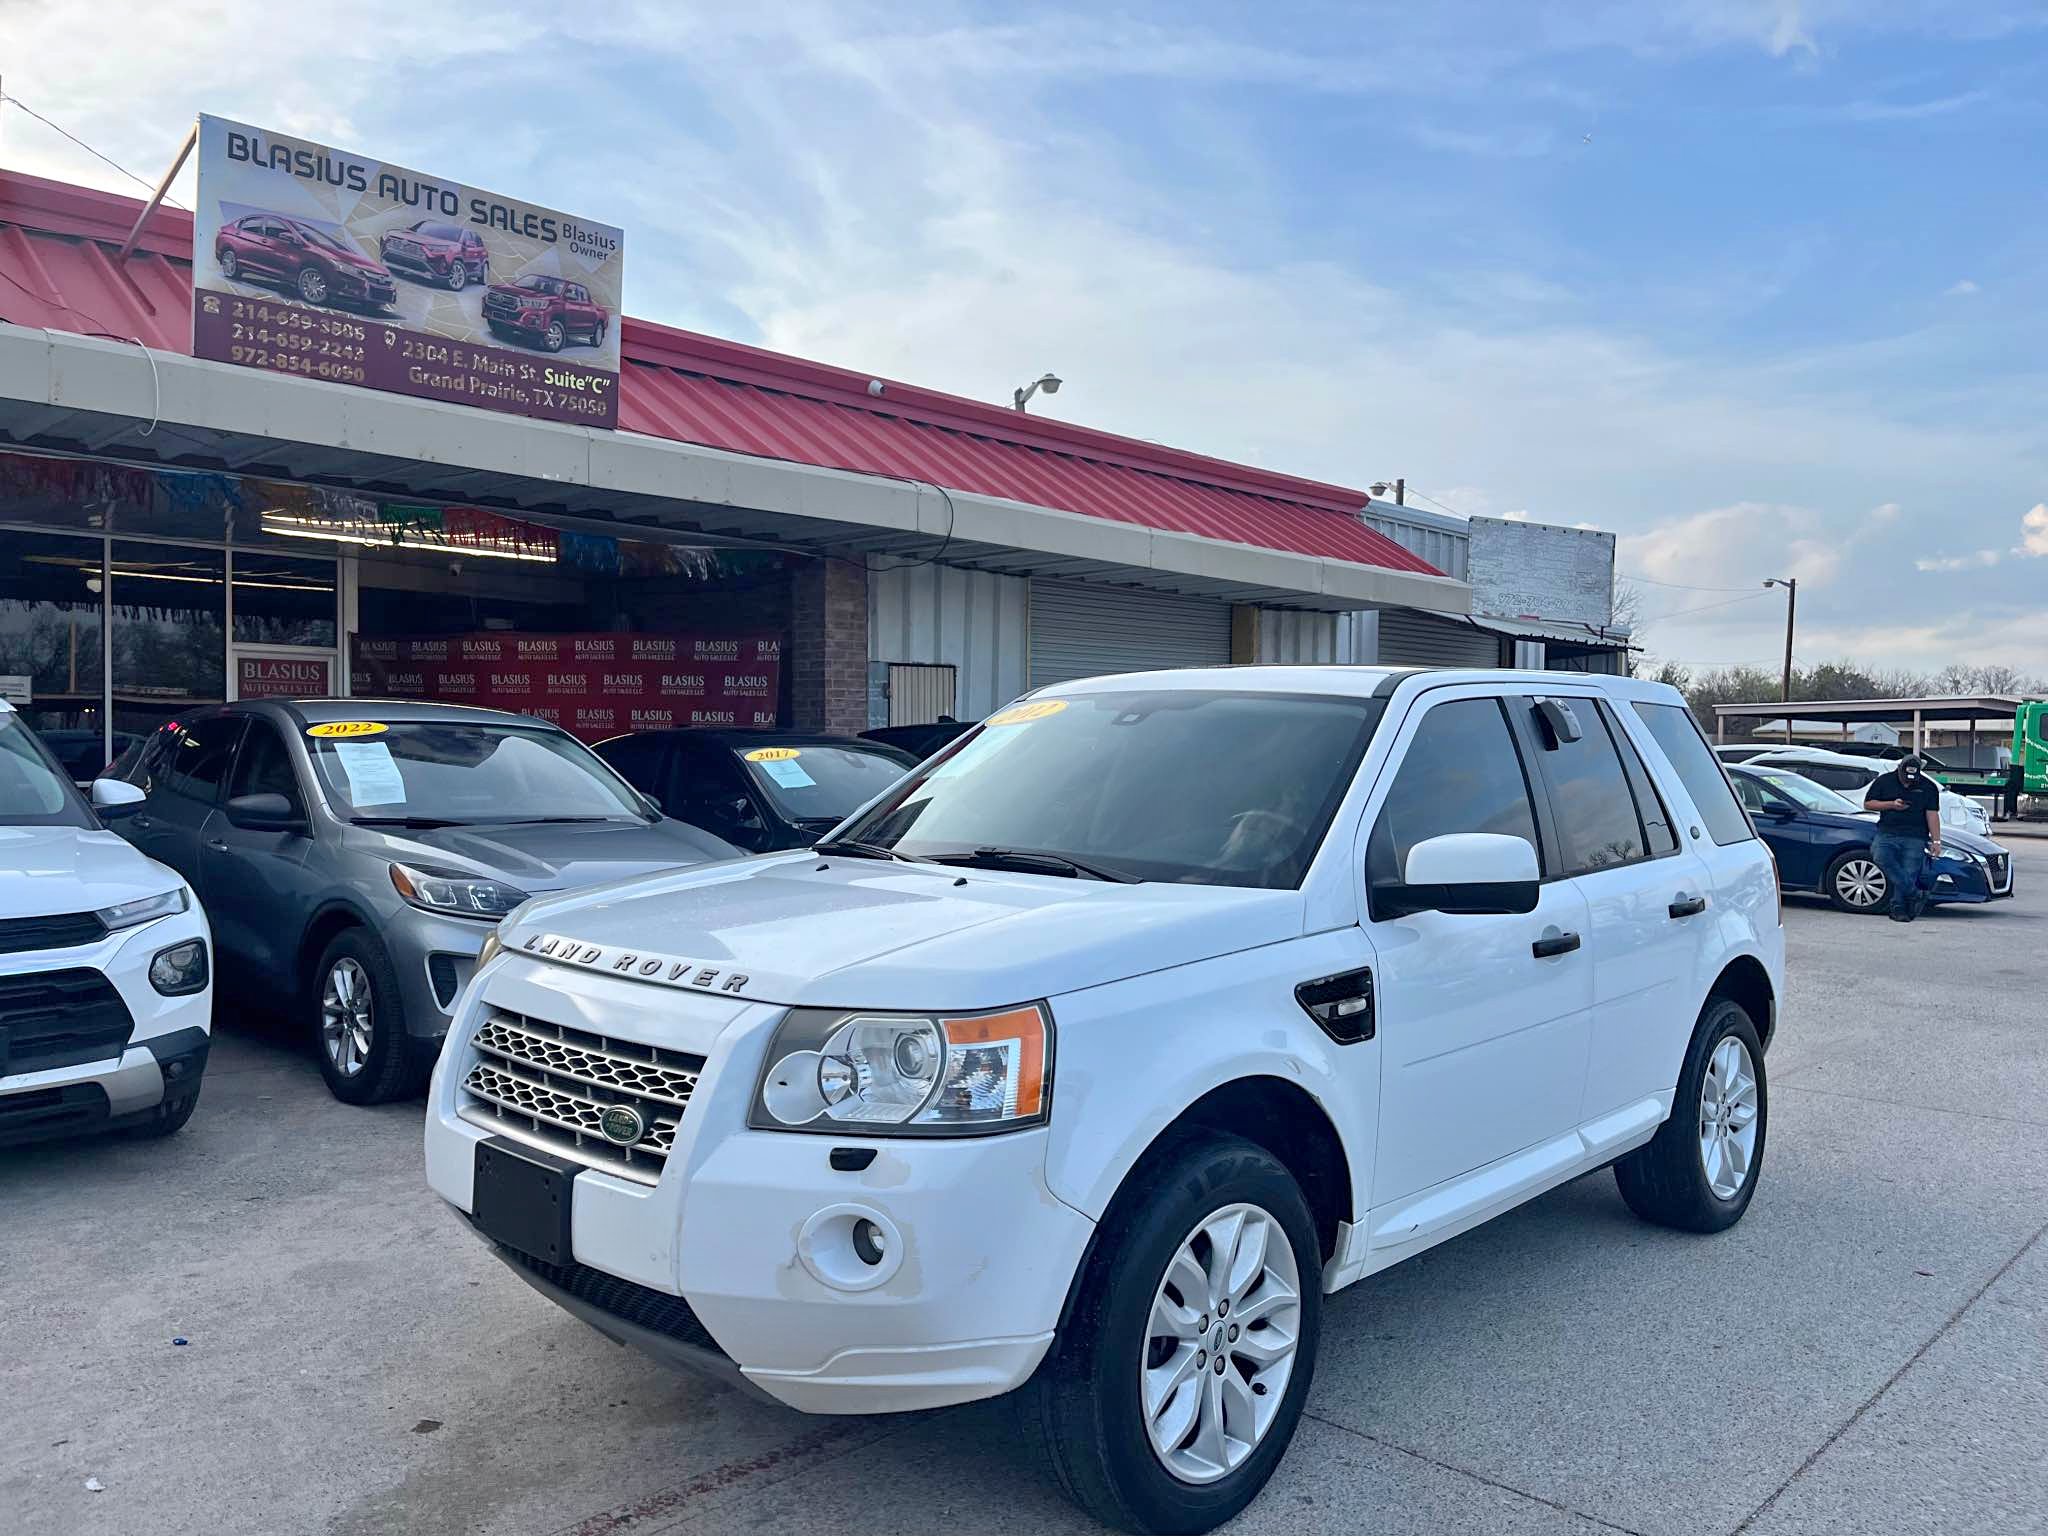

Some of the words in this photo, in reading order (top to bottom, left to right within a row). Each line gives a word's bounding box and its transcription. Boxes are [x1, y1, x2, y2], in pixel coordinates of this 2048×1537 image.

[227, 132, 367, 192] BLASIUS
[379, 174, 459, 217] AUTO
[470, 199, 558, 243] SALES
[562, 223, 617, 251] Blasius
[569, 242, 609, 262] Owner
[452, 351, 469, 369] E.
[473, 353, 516, 378] Main
[408, 366, 465, 391] Grand
[469, 376, 530, 404] Prairie,
[533, 388, 555, 408] TX
[462, 641, 501, 651] BLASIUS
[518, 641, 557, 651] BLASIUS
[575, 640, 615, 651] BLASIUS
[633, 640, 675, 651] BLASIUS
[695, 640, 738, 652] BLASIUS
[244, 662, 320, 681] BLASIUS
[438, 674, 475, 684] BLASIUS
[491, 674, 530, 685] BLASIUS
[547, 675, 586, 685] BLASIUS
[603, 675, 643, 685] BLASIUS
[662, 675, 704, 686] BLASIUS
[724, 676, 768, 687] BLASIUS
[242, 683, 271, 693] AUTO
[577, 708, 615, 719] BLASIUS
[631, 710, 672, 721] BLASIUS
[691, 711, 735, 722] BLASIUS
[323, 723, 373, 735] 2022
[757, 750, 789, 760] 2017
[523, 935, 602, 964] LAND
[613, 953, 751, 993] ROVER
